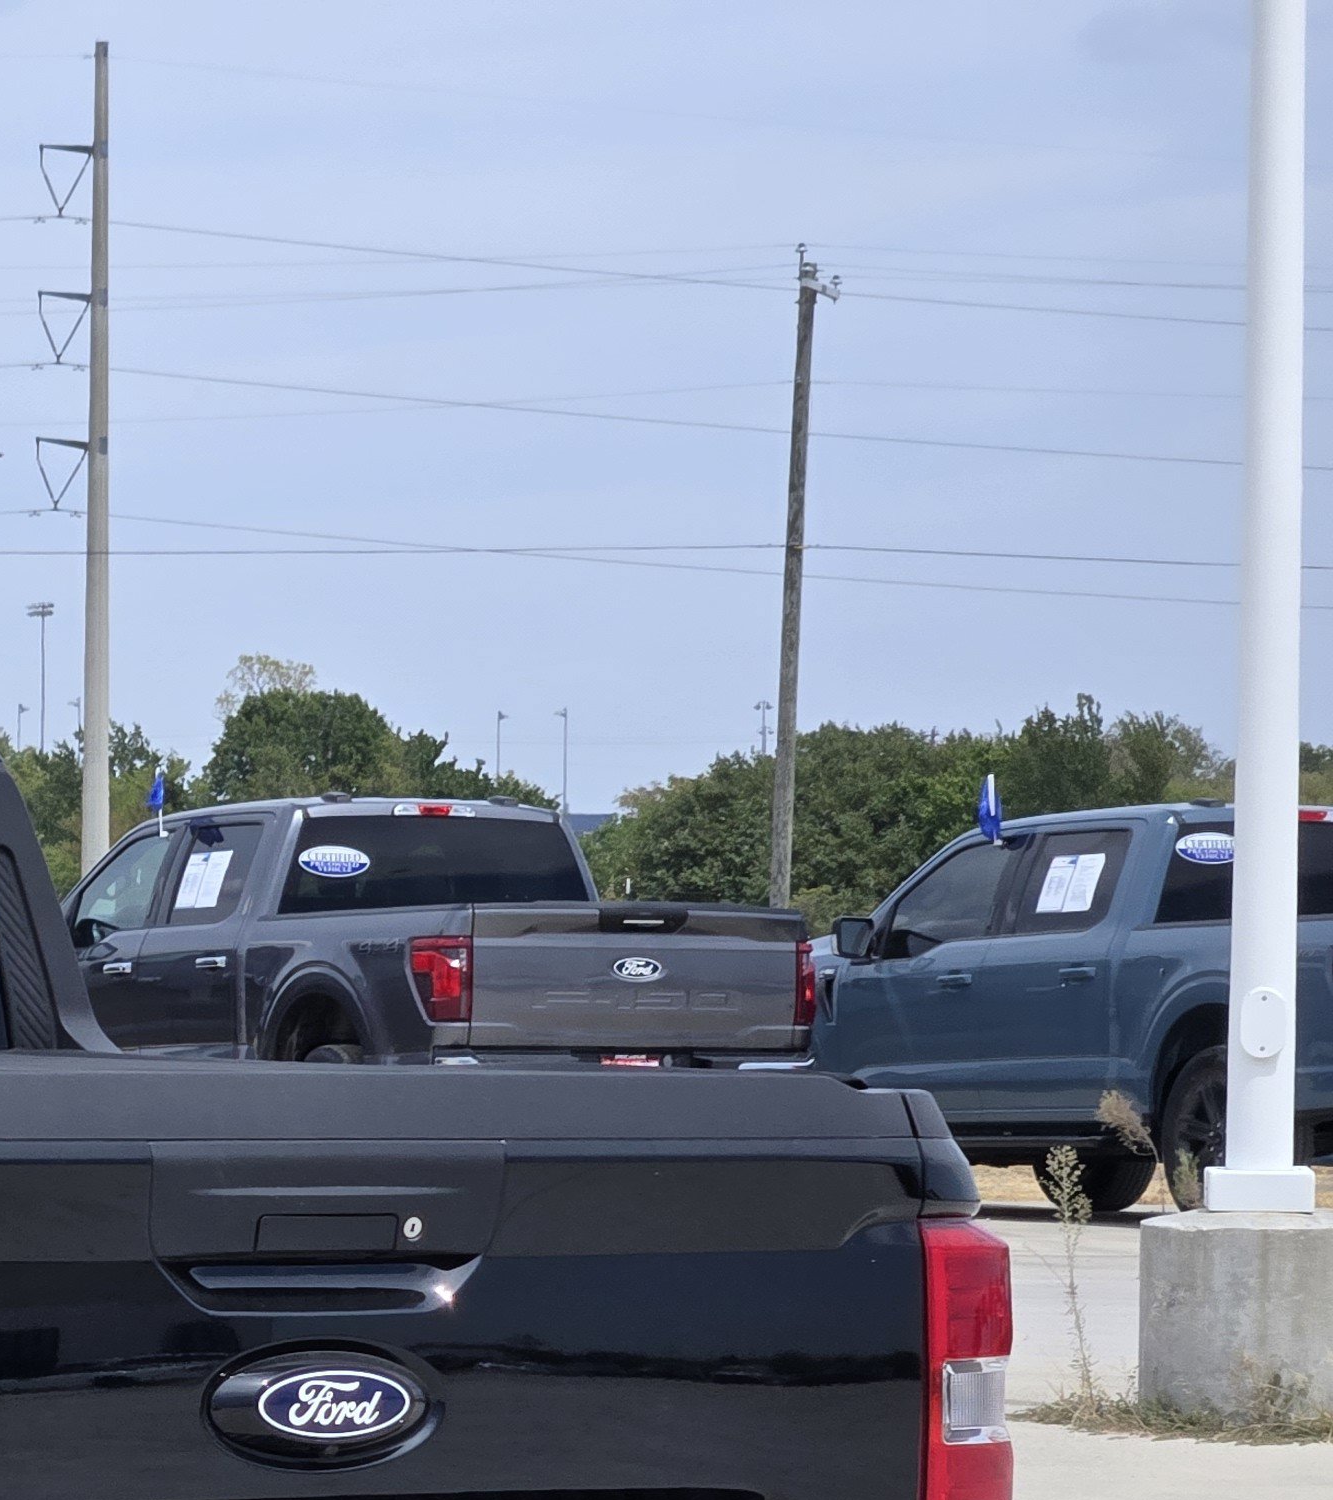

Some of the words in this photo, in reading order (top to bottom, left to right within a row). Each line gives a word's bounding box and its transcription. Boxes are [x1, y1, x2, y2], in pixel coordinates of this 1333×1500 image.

[307, 851, 361, 862] CERTIFIED
[621, 959, 655, 976] Ford
[288, 1380, 383, 1426] Ford
